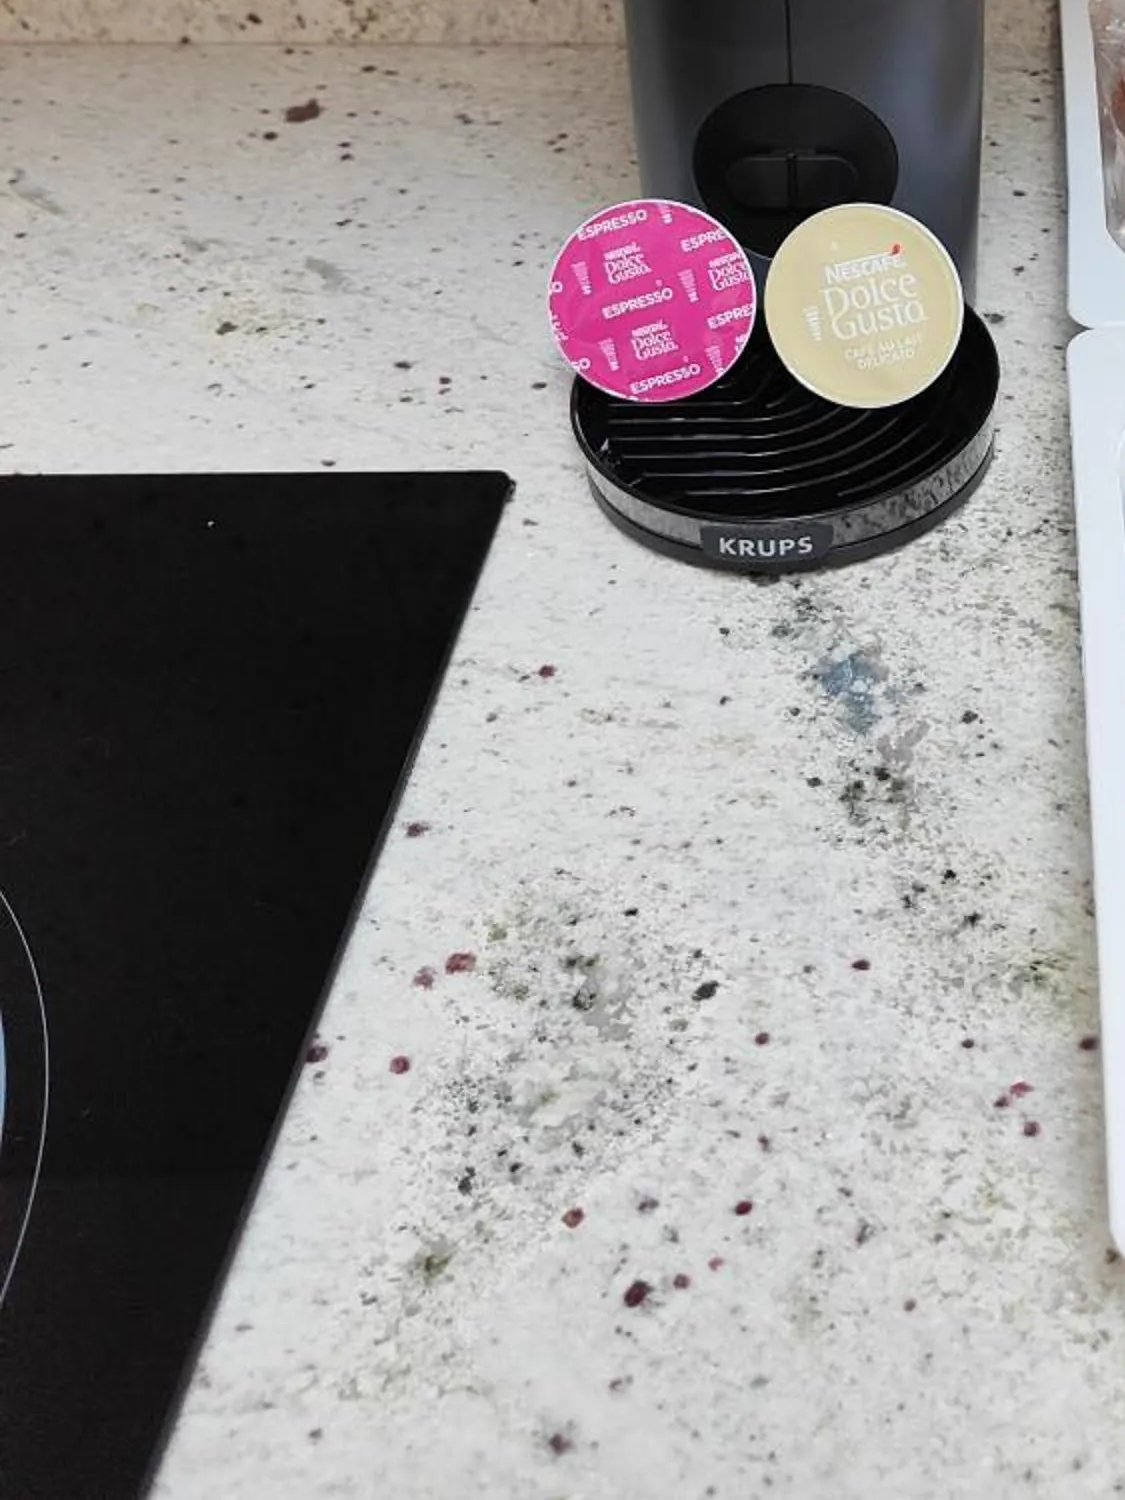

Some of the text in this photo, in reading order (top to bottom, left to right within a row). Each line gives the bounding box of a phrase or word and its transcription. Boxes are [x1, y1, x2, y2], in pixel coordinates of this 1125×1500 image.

[577, 209, 647, 241] ESPRESSO
[602, 287, 673, 320] ESPRESSO
[630, 363, 701, 394] ESPRESSO
[719, 534, 813, 558] KRUPS
